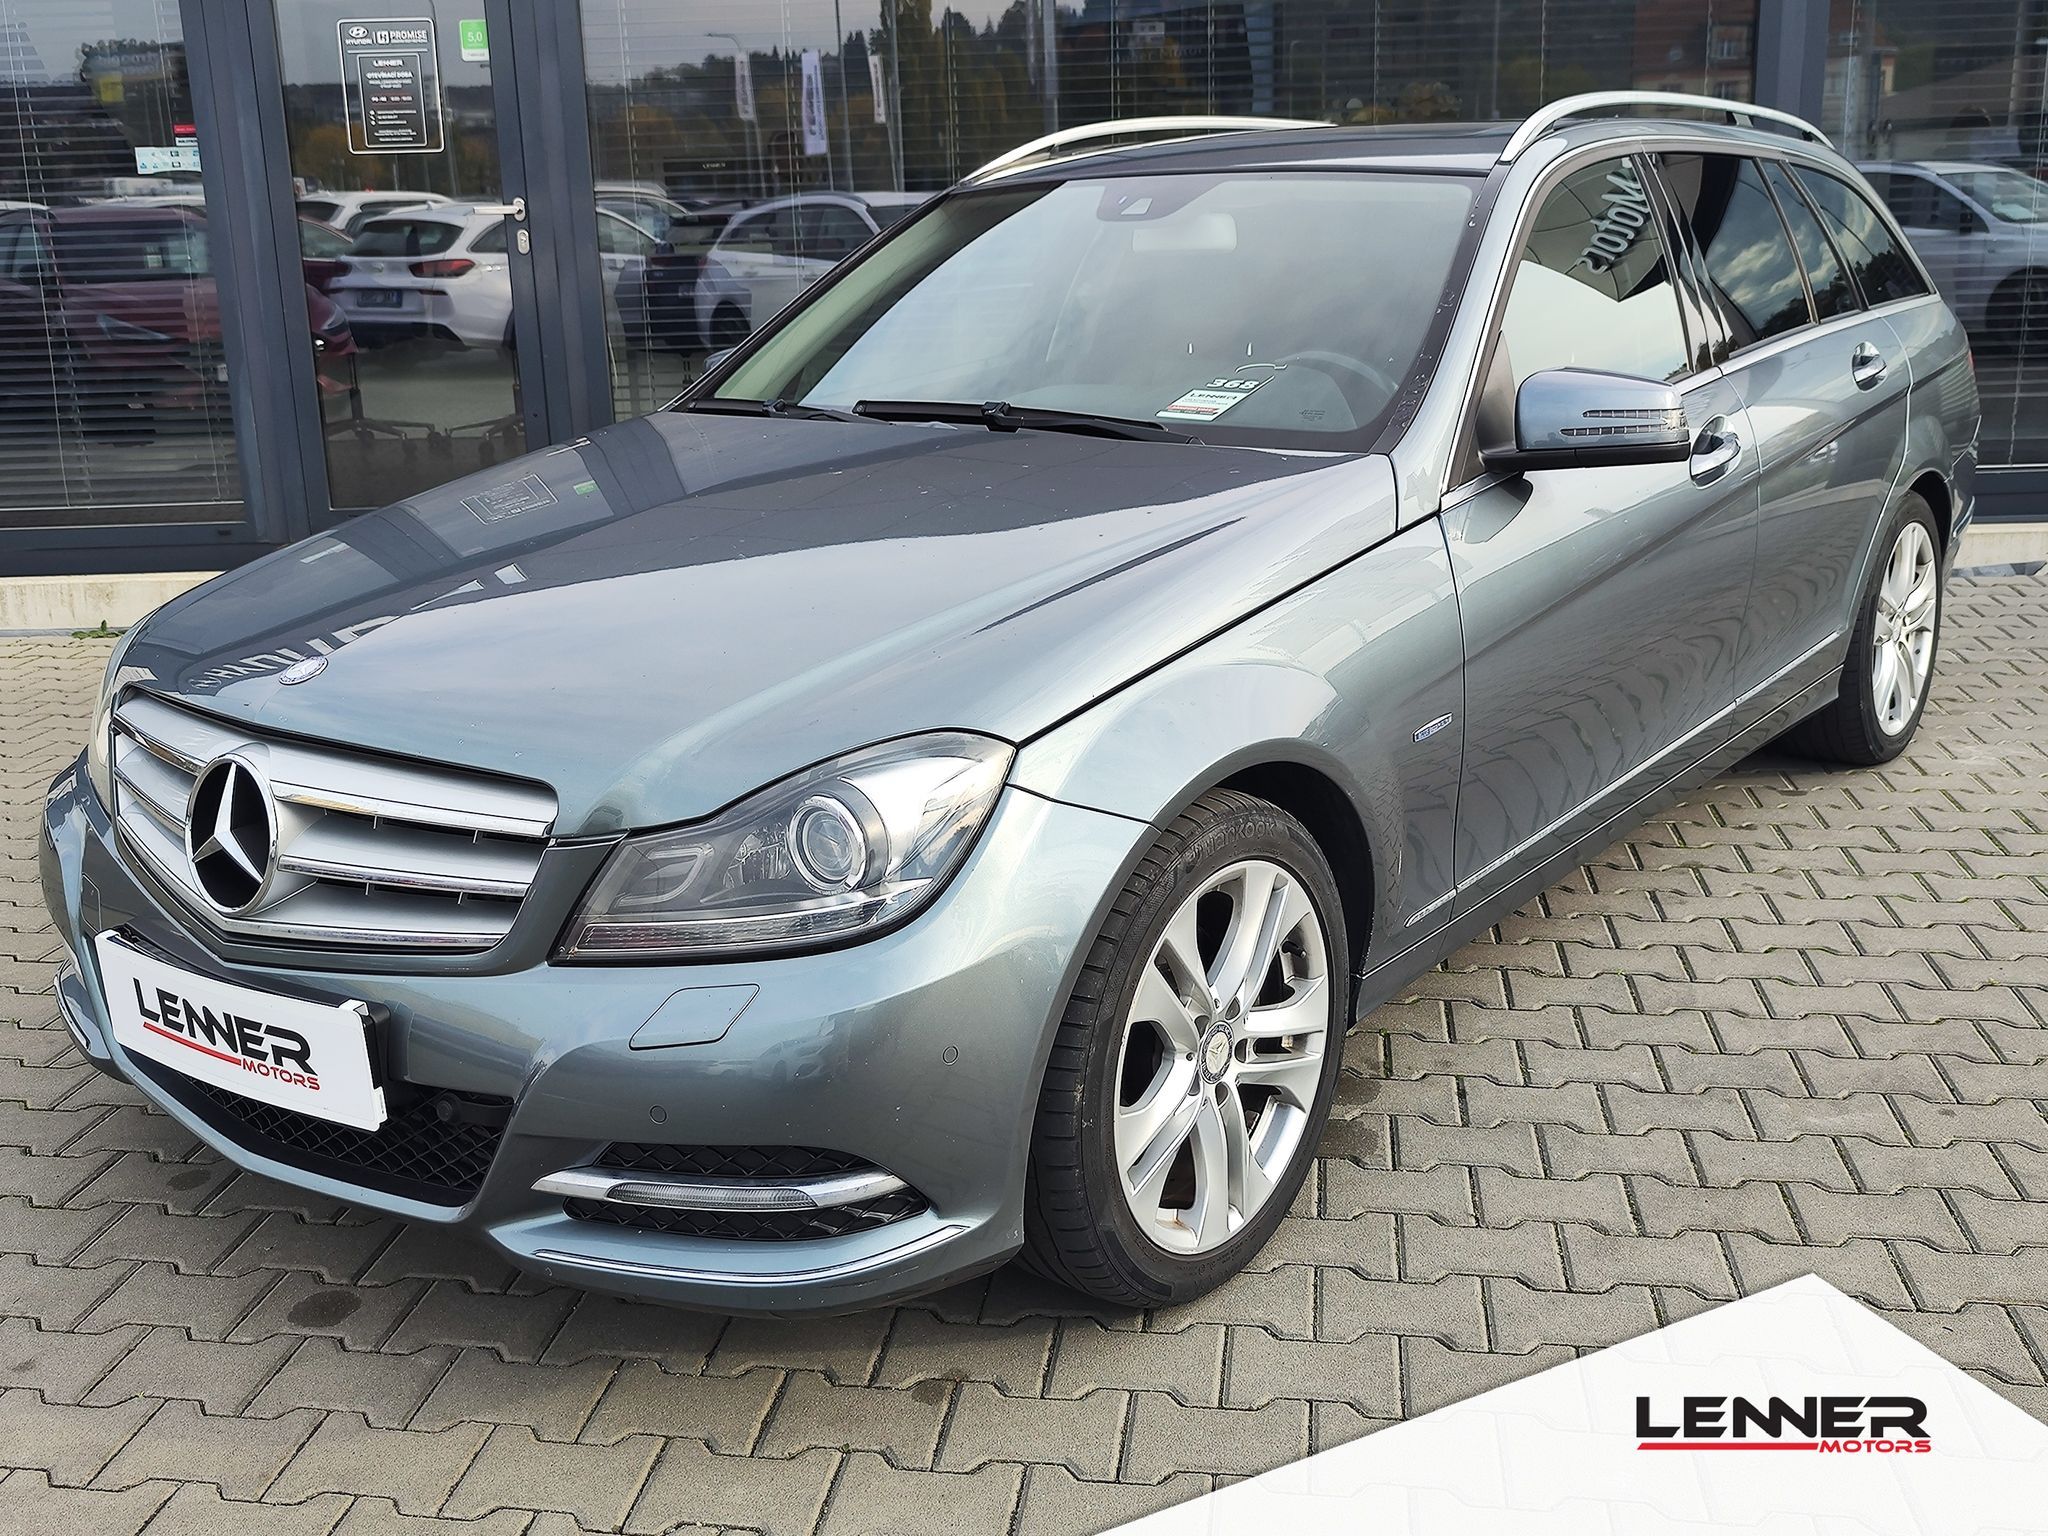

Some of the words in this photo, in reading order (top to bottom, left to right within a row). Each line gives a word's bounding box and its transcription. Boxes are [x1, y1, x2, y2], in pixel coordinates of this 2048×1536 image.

[390, 30, 427, 40] PROMISE
[467, 31, 483, 43] 5,0
[345, 38, 373, 46] HYUNDAI
[1206, 377, 1260, 390] 368
[133, 977, 318, 1076] LENNER
[243, 1058, 321, 1091] MOTORS
